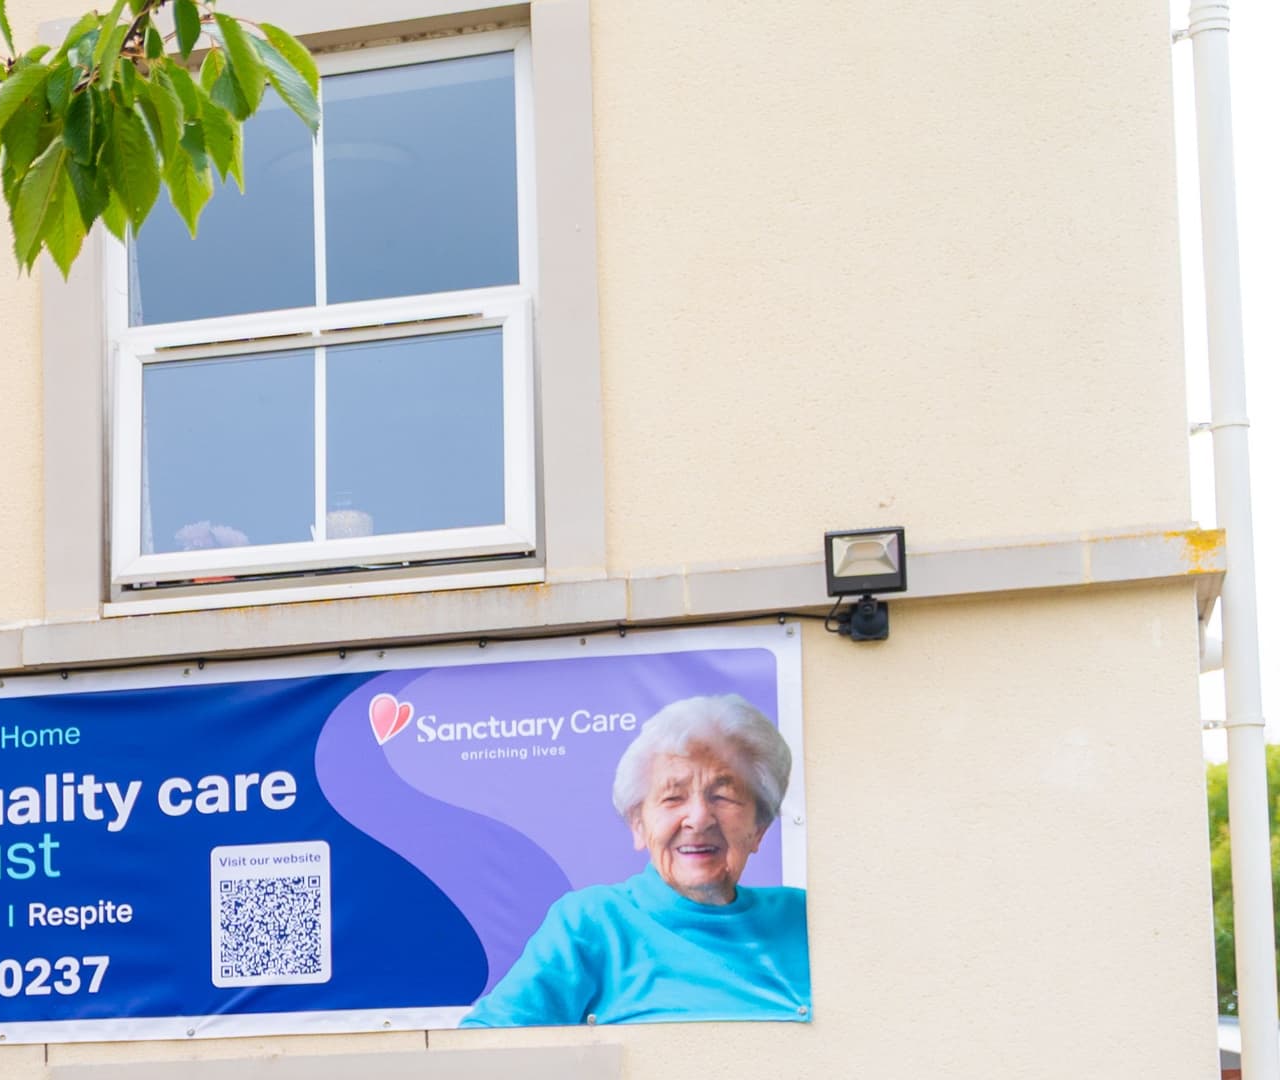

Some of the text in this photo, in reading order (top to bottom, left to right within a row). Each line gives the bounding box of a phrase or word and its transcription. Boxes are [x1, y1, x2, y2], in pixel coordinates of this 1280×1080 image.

[0, 726, 80, 750] Home
[416, 709, 637, 744] Sanctuary Care
[460, 744, 567, 762] enriching lives
[157, 768, 297, 817] care
[219, 852, 322, 867] Visit our website
[28, 899, 134, 931] Respite
